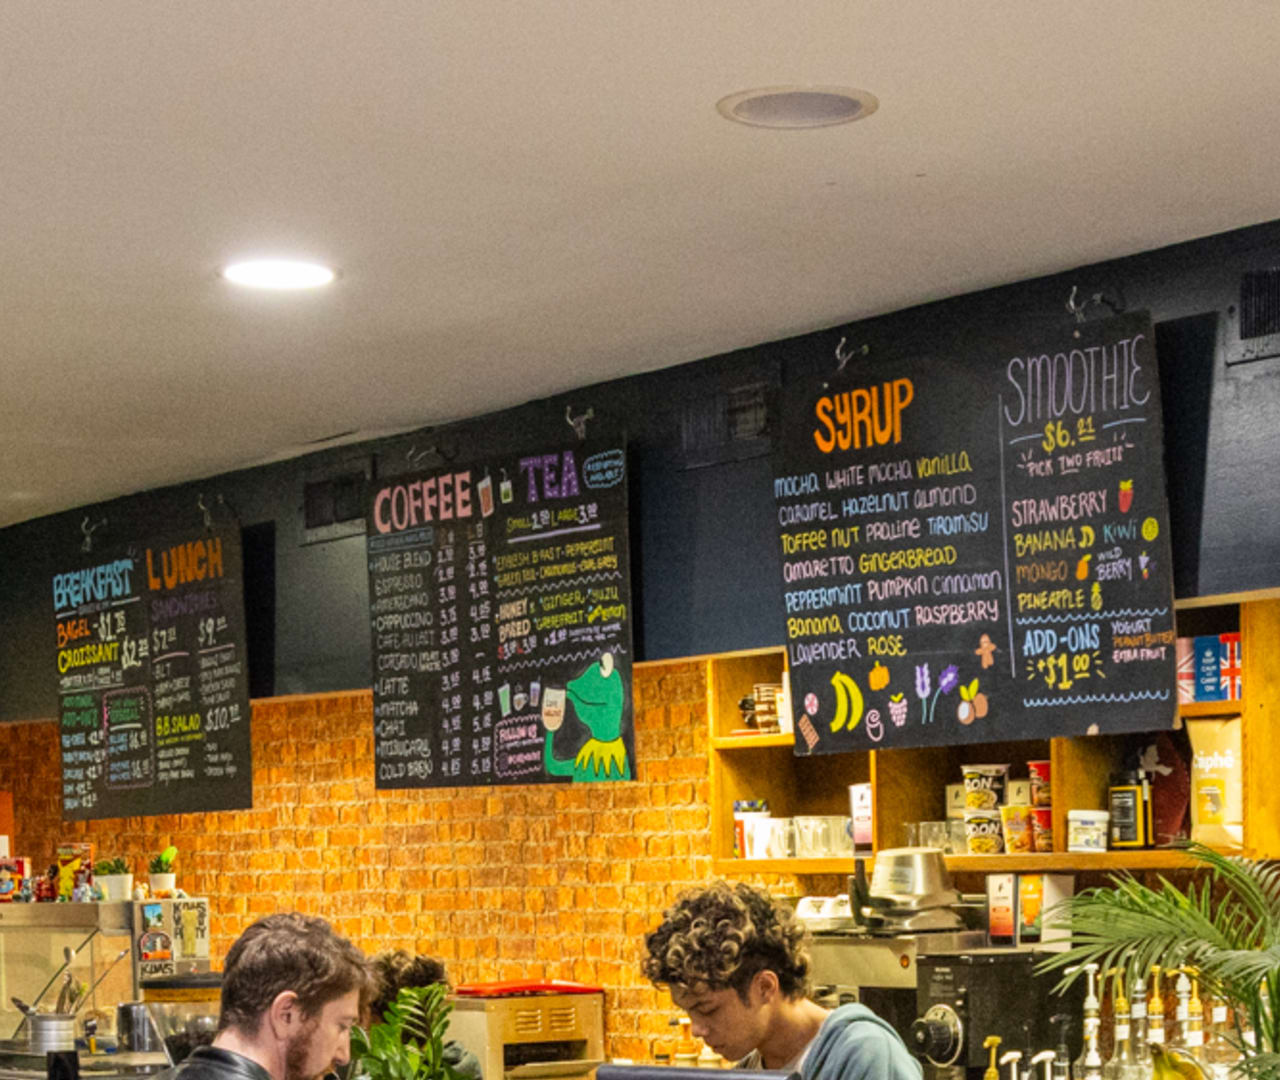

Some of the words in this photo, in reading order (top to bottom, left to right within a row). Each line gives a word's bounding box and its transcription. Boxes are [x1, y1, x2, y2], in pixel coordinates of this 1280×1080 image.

[1004, 334, 1151, 426] SMOOTHIE
[814, 378, 914, 454] SYRUP
[520, 450, 580, 502] TEA
[1058, 454, 1083, 470] TWO
[374, 470, 472, 534] COFFEE
[1012, 489, 1107, 527] STRAWBERRY
[1014, 527, 1076, 557] BANANA
[146, 537, 223, 591] LUNCH
[52, 559, 134, 612] BREAKFAST
[1018, 589, 1085, 612] PINEAPPLE
[56, 618, 91, 648] BAGEL
[1024, 624, 1100, 656] ADD-ONS
[58, 642, 119, 674] CROISSANT
[379, 676, 410, 696] LATTE
